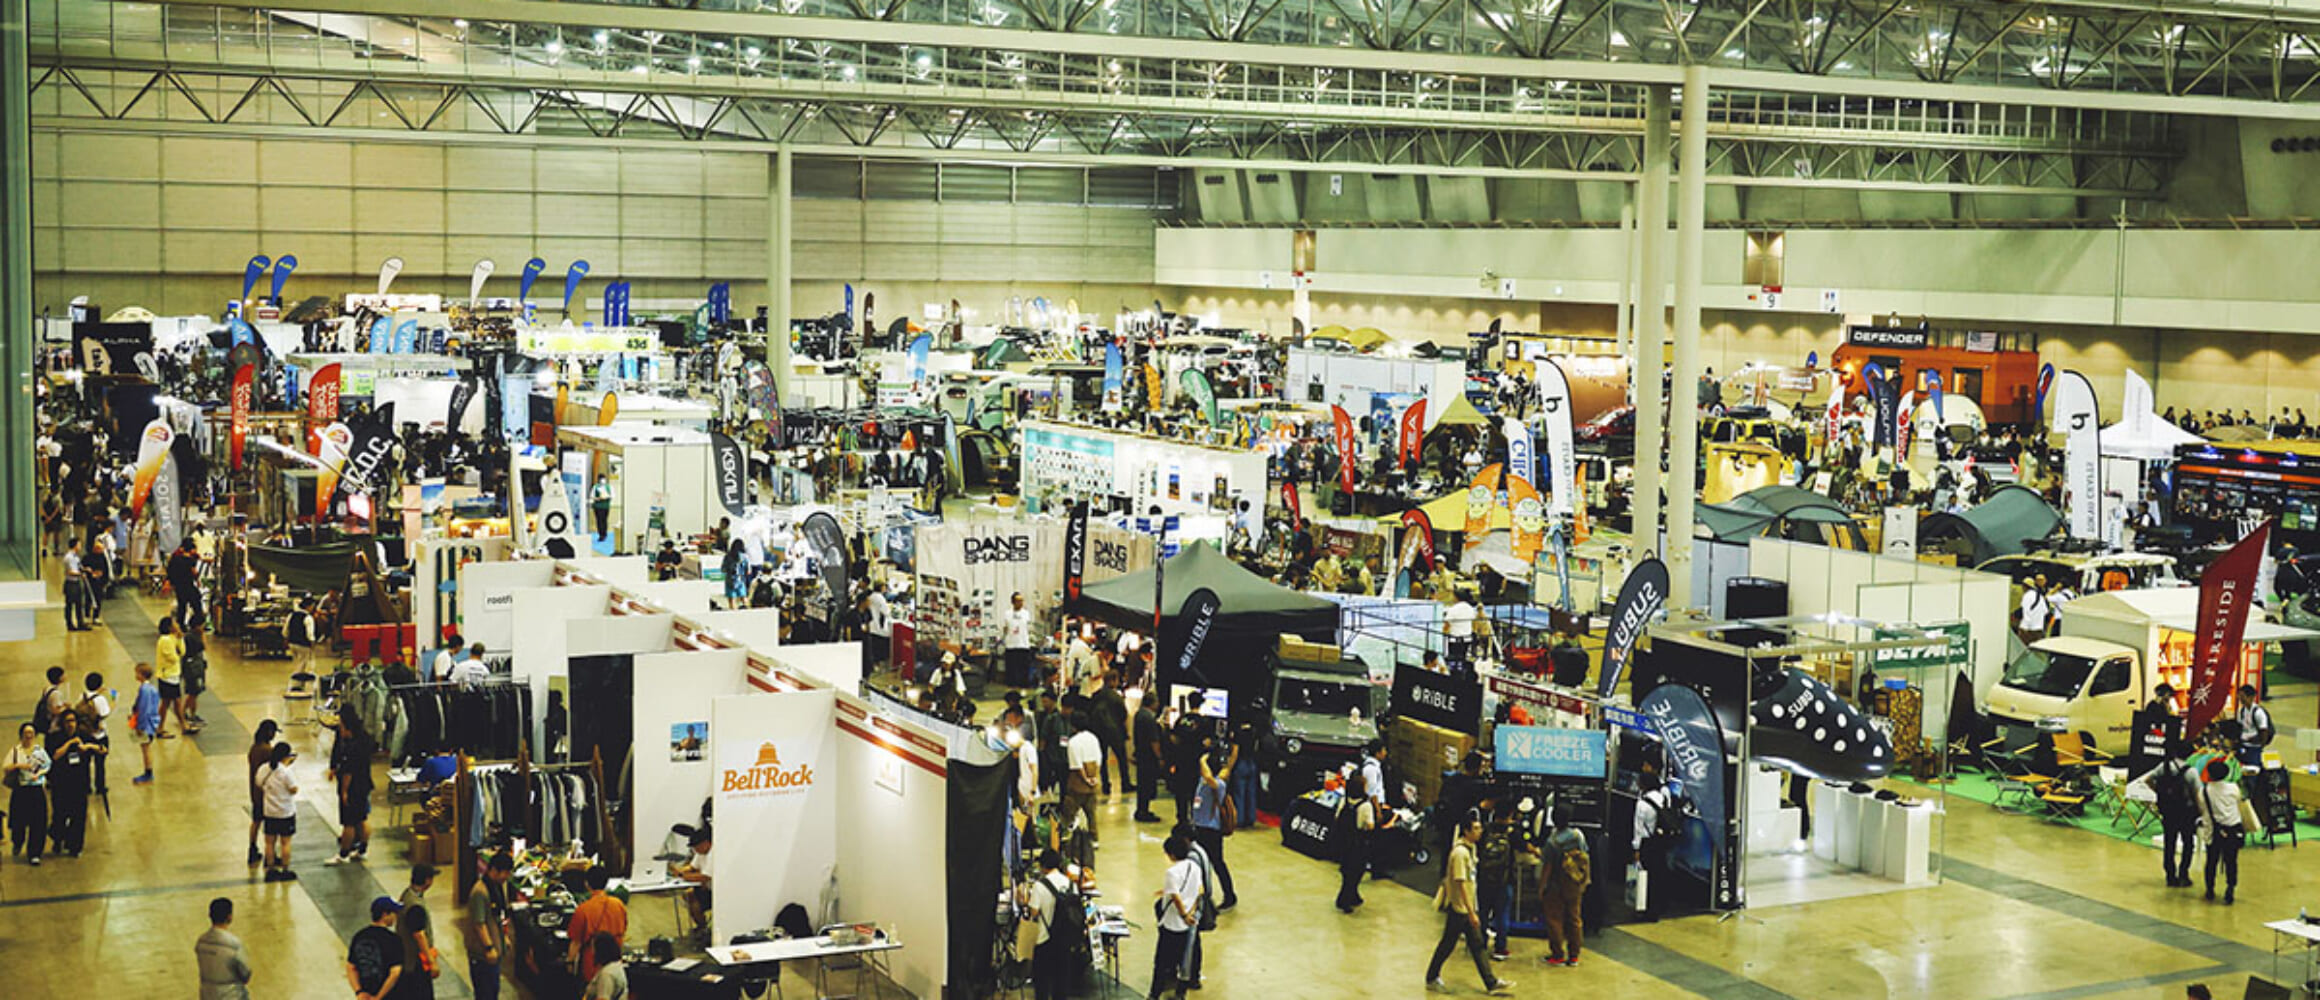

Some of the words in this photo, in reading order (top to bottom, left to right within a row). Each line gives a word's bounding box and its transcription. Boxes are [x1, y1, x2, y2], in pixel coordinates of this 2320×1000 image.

[1853, 331, 1925, 344] DEFENDER
[963, 535, 1030, 551] DANG
[1093, 538, 1128, 561] DANG
[963, 551, 1030, 564] SHADES
[2206, 579, 2236, 677] FIRESIDE
[1534, 733, 1590, 749] FREEZE
[1532, 748, 1592, 762] COOLER
